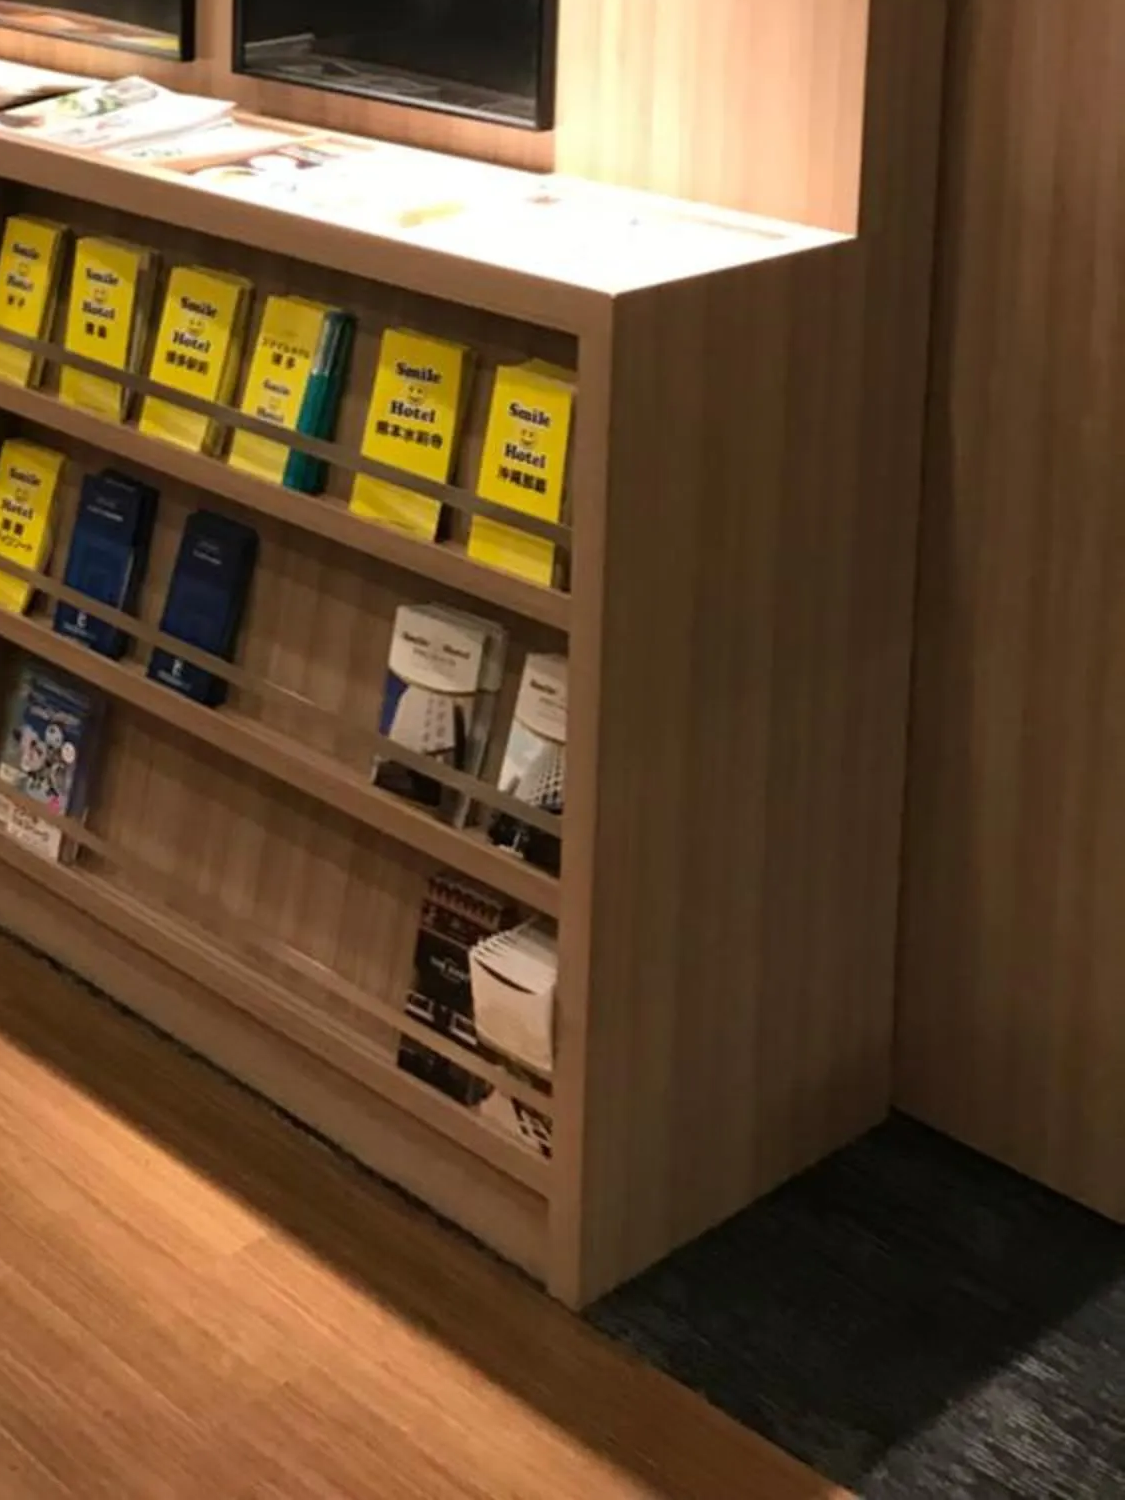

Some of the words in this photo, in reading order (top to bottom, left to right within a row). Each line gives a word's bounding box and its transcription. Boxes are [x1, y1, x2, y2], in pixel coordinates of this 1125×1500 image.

[180, 296, 217, 318] Smile
[172, 331, 211, 353] Hotel
[394, 360, 442, 384] Smile
[390, 399, 436, 424] Hotel
[508, 401, 551, 427] Smile
[503, 442, 547, 469] Hotel
